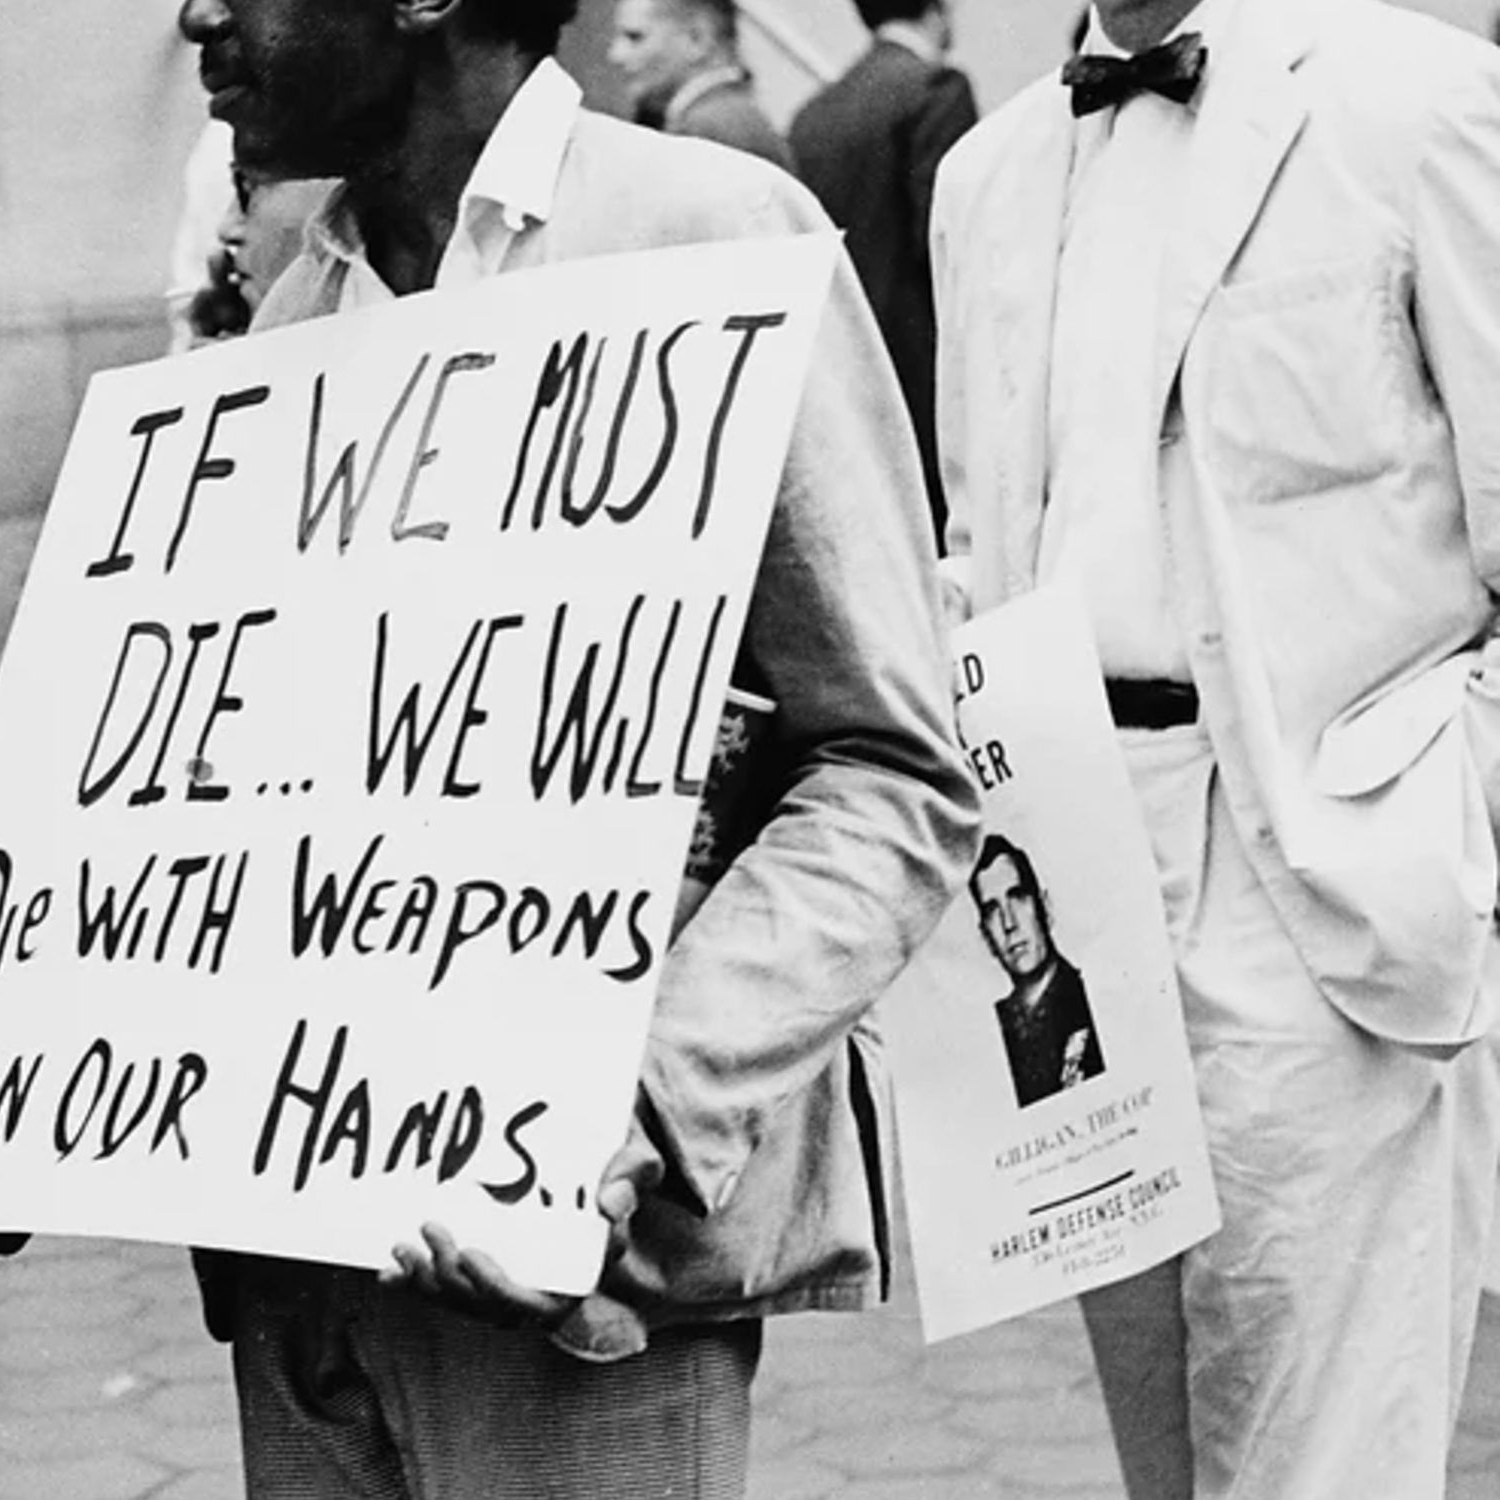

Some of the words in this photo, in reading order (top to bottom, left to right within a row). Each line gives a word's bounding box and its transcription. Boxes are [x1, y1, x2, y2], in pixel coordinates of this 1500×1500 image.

[86, 386, 270, 577] IF
[297, 353, 496, 556] WE
[501, 312, 786, 540] MUST
[366, 613, 525, 798] WE
[291, 835, 653, 991] WEAPONS
[54, 1037, 208, 1163] OUR
[991, 1222, 1050, 1264] HARLEM
[1056, 1193, 1125, 1241] DEFENSE
[1128, 1166, 1181, 1210] COUNCIL
